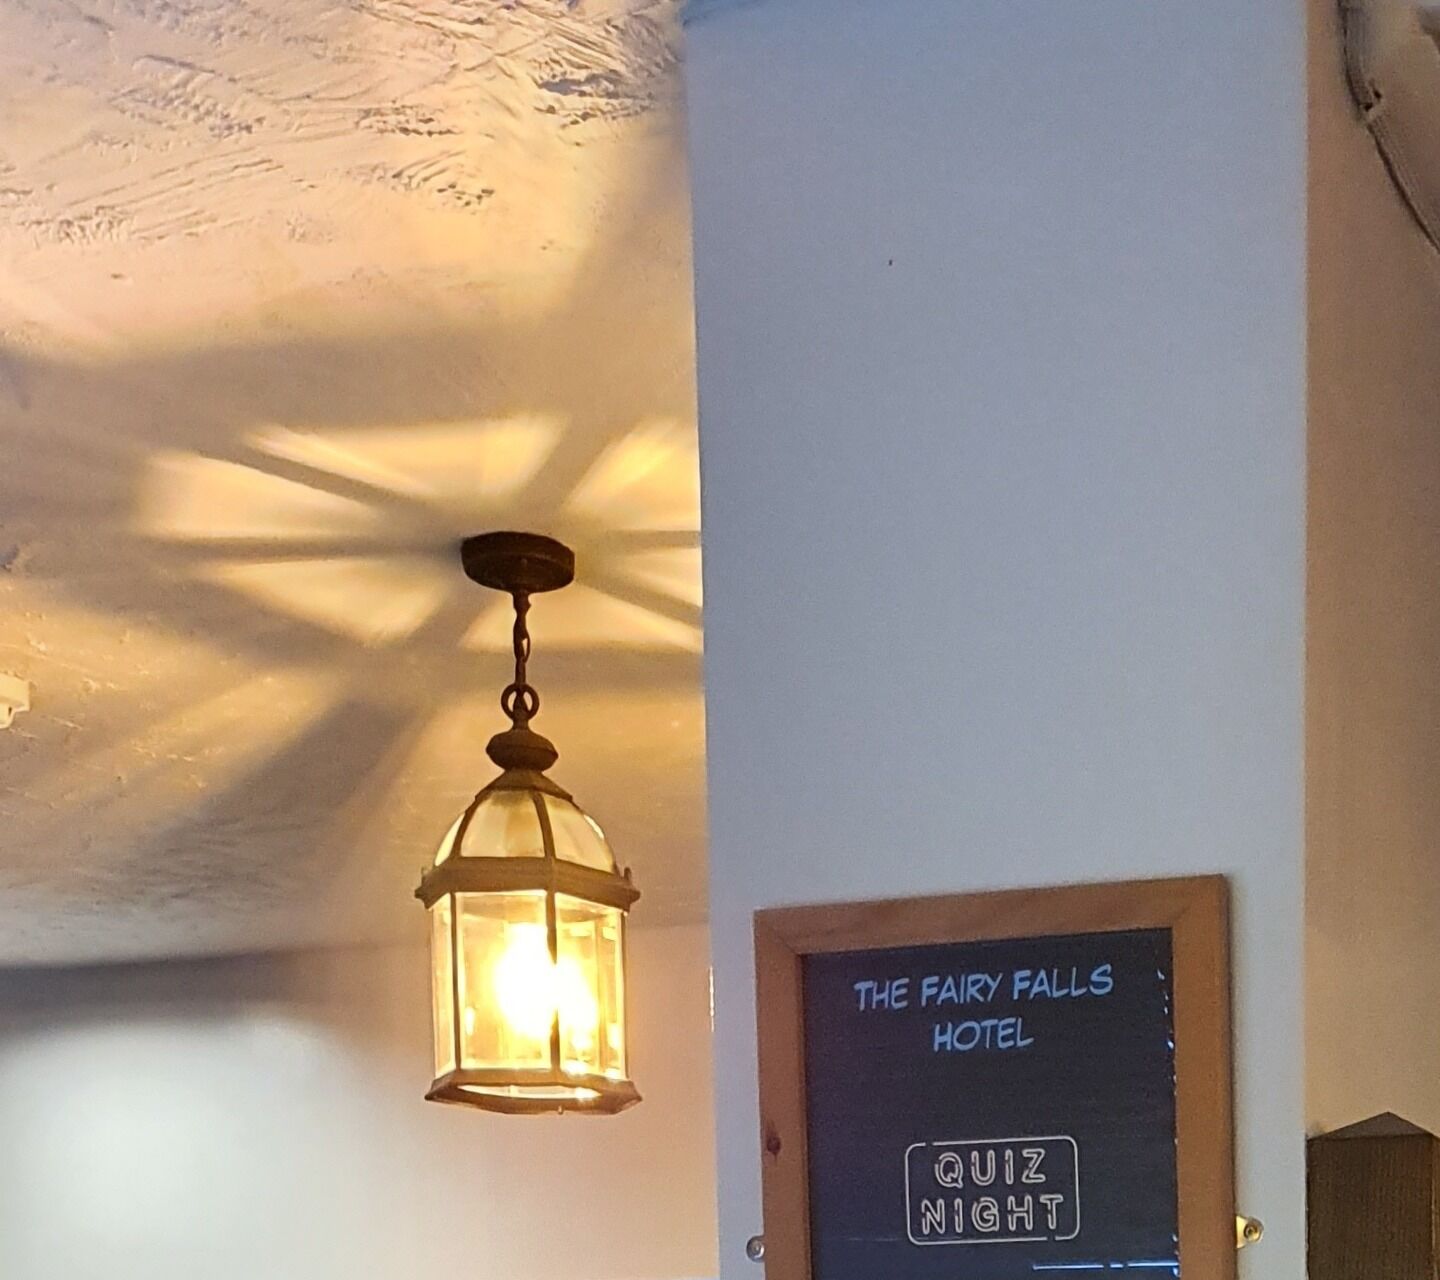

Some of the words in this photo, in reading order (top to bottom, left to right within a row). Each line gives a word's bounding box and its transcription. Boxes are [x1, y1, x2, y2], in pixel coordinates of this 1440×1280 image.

[854, 977, 909, 1011] THE
[920, 972, 1004, 1007] FAIRY
[1012, 964, 1114, 1000] FALLS
[932, 1017, 1035, 1052] HOTEL
[934, 1147, 1046, 1189] QUIZ
[920, 1193, 1065, 1235] NIGHT
